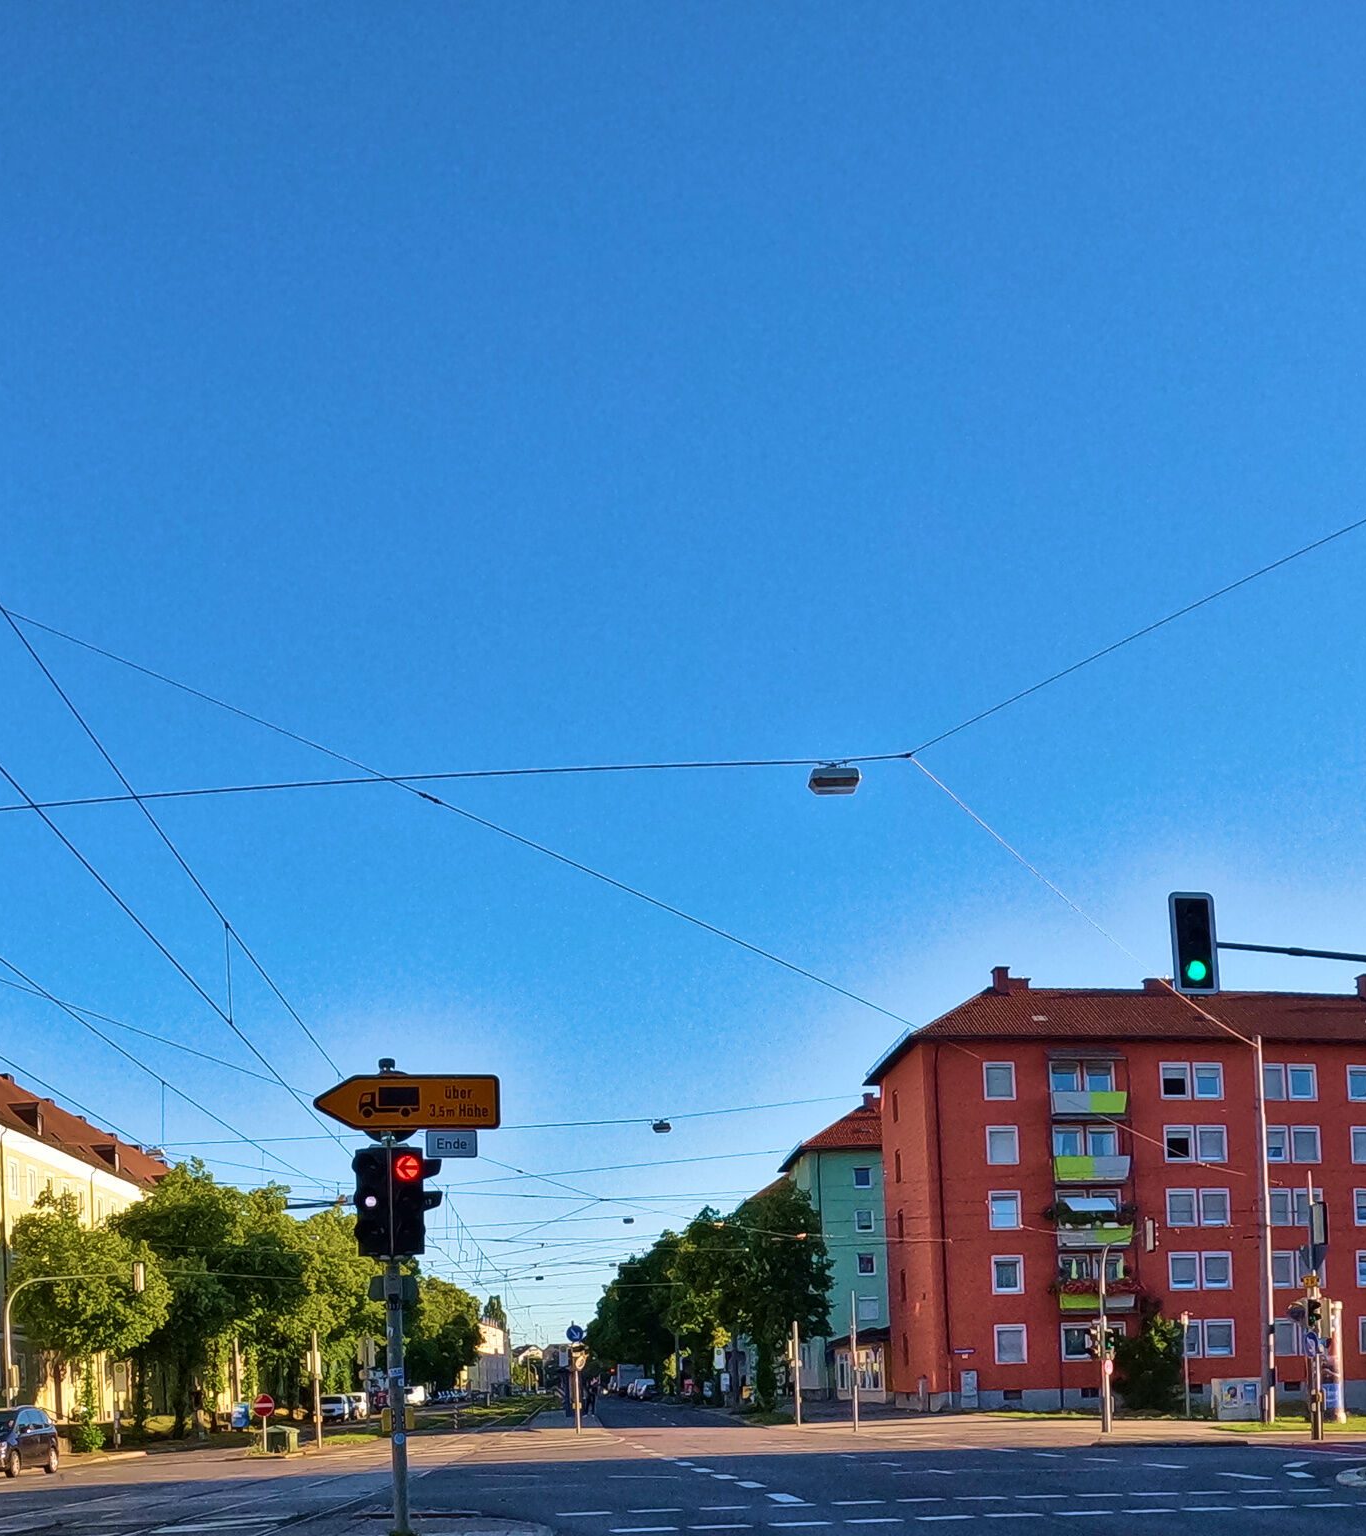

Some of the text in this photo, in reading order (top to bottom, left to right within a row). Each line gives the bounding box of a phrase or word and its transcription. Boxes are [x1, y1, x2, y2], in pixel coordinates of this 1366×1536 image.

[444, 1085, 473, 1100] über
[459, 1103, 489, 1118] Höhe
[436, 1137, 468, 1150] Ende
